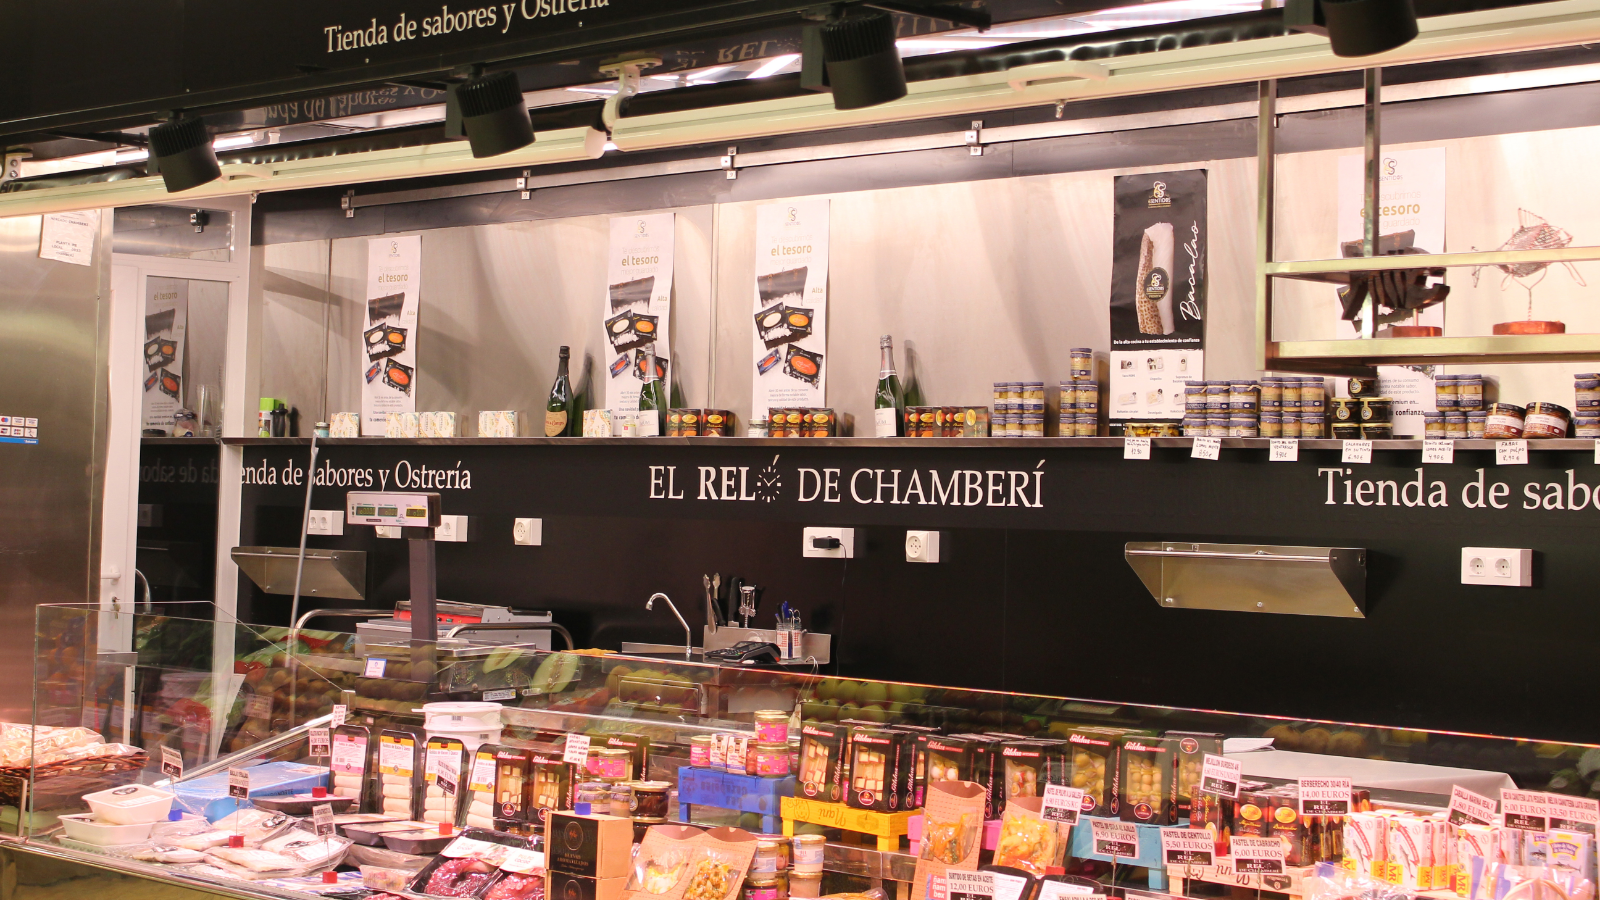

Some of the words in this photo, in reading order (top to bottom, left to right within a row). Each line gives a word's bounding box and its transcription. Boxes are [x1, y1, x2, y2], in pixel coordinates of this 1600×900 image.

[324, 18, 388, 53] Tienda
[393, 13, 417, 42] de
[422, 5, 497, 36] sabores
[502, 3, 515, 33] y
[771, 245, 780, 256] el
[782, 245, 812, 255] tesoro
[622, 255, 630, 266] el
[632, 256, 659, 265] tesoro
[1180, 220, 1201, 320] Bacalao
[378, 273, 385, 283] el
[386, 274, 408, 282] tesoro
[282, 459, 303, 485] de
[378, 469, 390, 492] y
[395, 460, 471, 489] Ostrería
[649, 466, 684, 499] EL
[798, 468, 841, 503] DE
[850, 459, 1045, 508] CHAMBERÍ
[1318, 467, 1448, 508] Tienda
[1461, 468, 1510, 509] de
[1070, 733, 1090, 744] Gildas
[1124, 741, 1146, 751] Gildas
[1467, 805, 1493, 821] EUROS
[1504, 802, 1518, 811] 6,00
[1520, 804, 1546, 815] EUROS
[1549, 807, 1567, 817] 13,50
[1570, 811, 1598, 822] EUROS
[1095, 831, 1109, 839] 6,90
[1111, 832, 1136, 841] EUROS
[1183, 841, 1213, 850] EUROS
[1235, 849, 1250, 857] 6,00
[1252, 849, 1282, 857] EUROS
[933, 884, 946, 892] ñam
[950, 883, 966, 891] 12,00
[969, 885, 993, 893] EUROS
